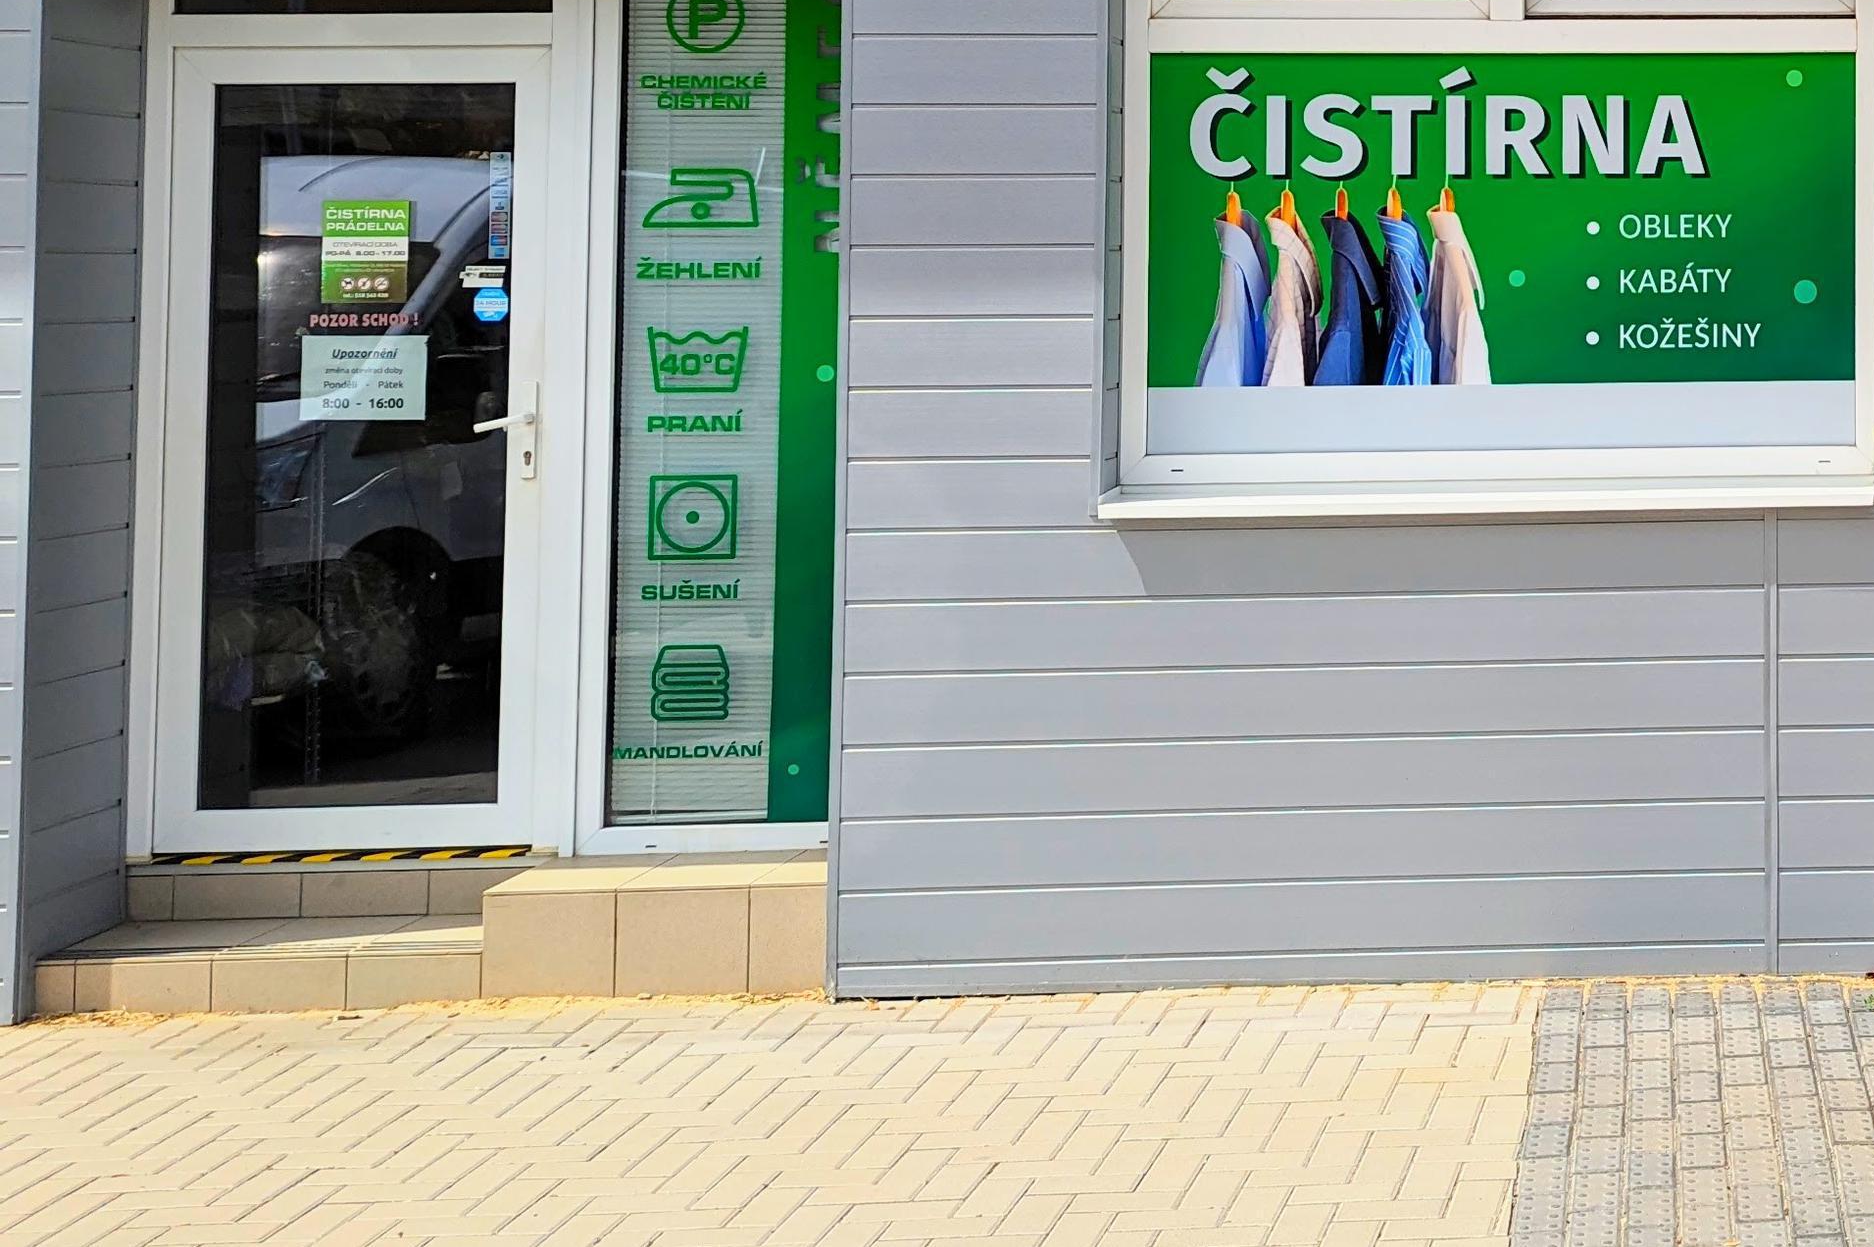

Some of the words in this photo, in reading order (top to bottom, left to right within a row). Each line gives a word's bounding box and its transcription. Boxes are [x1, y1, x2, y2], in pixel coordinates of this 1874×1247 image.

[640, 72, 768, 90] CHEMICKÉ
[1189, 66, 1708, 179] ČISTÍRNA
[326, 207, 406, 219] ČISTÍRNA
[326, 220, 405, 231] PRÁDELNA
[1619, 214, 1732, 240] OBLEKY
[636, 255, 762, 280] ŽEHLENÍ
[1618, 265, 1732, 295] KABÁTY
[309, 314, 358, 327] POZOR
[362, 314, 409, 327] SCHOD
[413, 314, 419, 326] !
[1618, 320, 1762, 350] KOŽEŠINY
[332, 348, 398, 359] Upozornění
[384, 367, 403, 376] doby
[659, 353, 736, 375] 40°C
[378, 380, 404, 389] Pátek
[323, 398, 350, 408] 8:00
[369, 398, 404, 408] 16:00
[647, 409, 743, 433] PRANÍ
[641, 578, 740, 601] SUŠENÍ
[613, 740, 763, 759] MANDLOVÁNÍ
